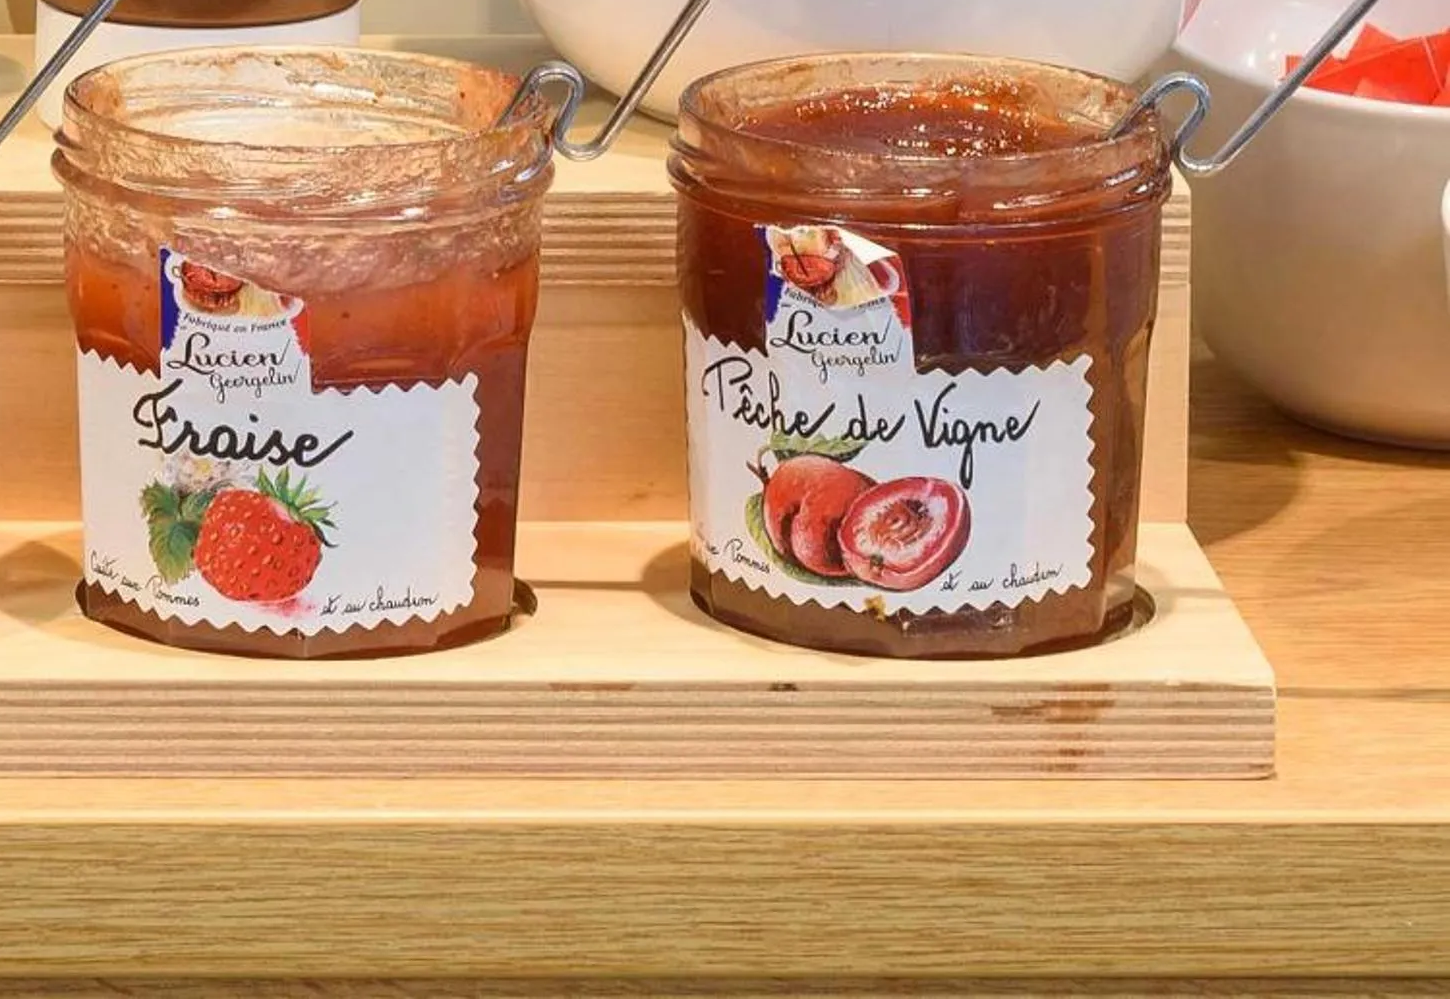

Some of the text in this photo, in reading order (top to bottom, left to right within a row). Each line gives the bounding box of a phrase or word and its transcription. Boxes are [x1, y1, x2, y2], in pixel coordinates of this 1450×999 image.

[166, 332, 291, 376] Lucien
[769, 310, 892, 354] Lucien
[209, 358, 302, 404] Georgelin
[811, 335, 903, 384] Georgelin
[132, 378, 355, 468] Fraise
[701, 356, 1042, 490] Pêche de Vigne
[939, 569, 963, 592] et
[967, 577, 995, 592] au
[320, 593, 343, 616] et
